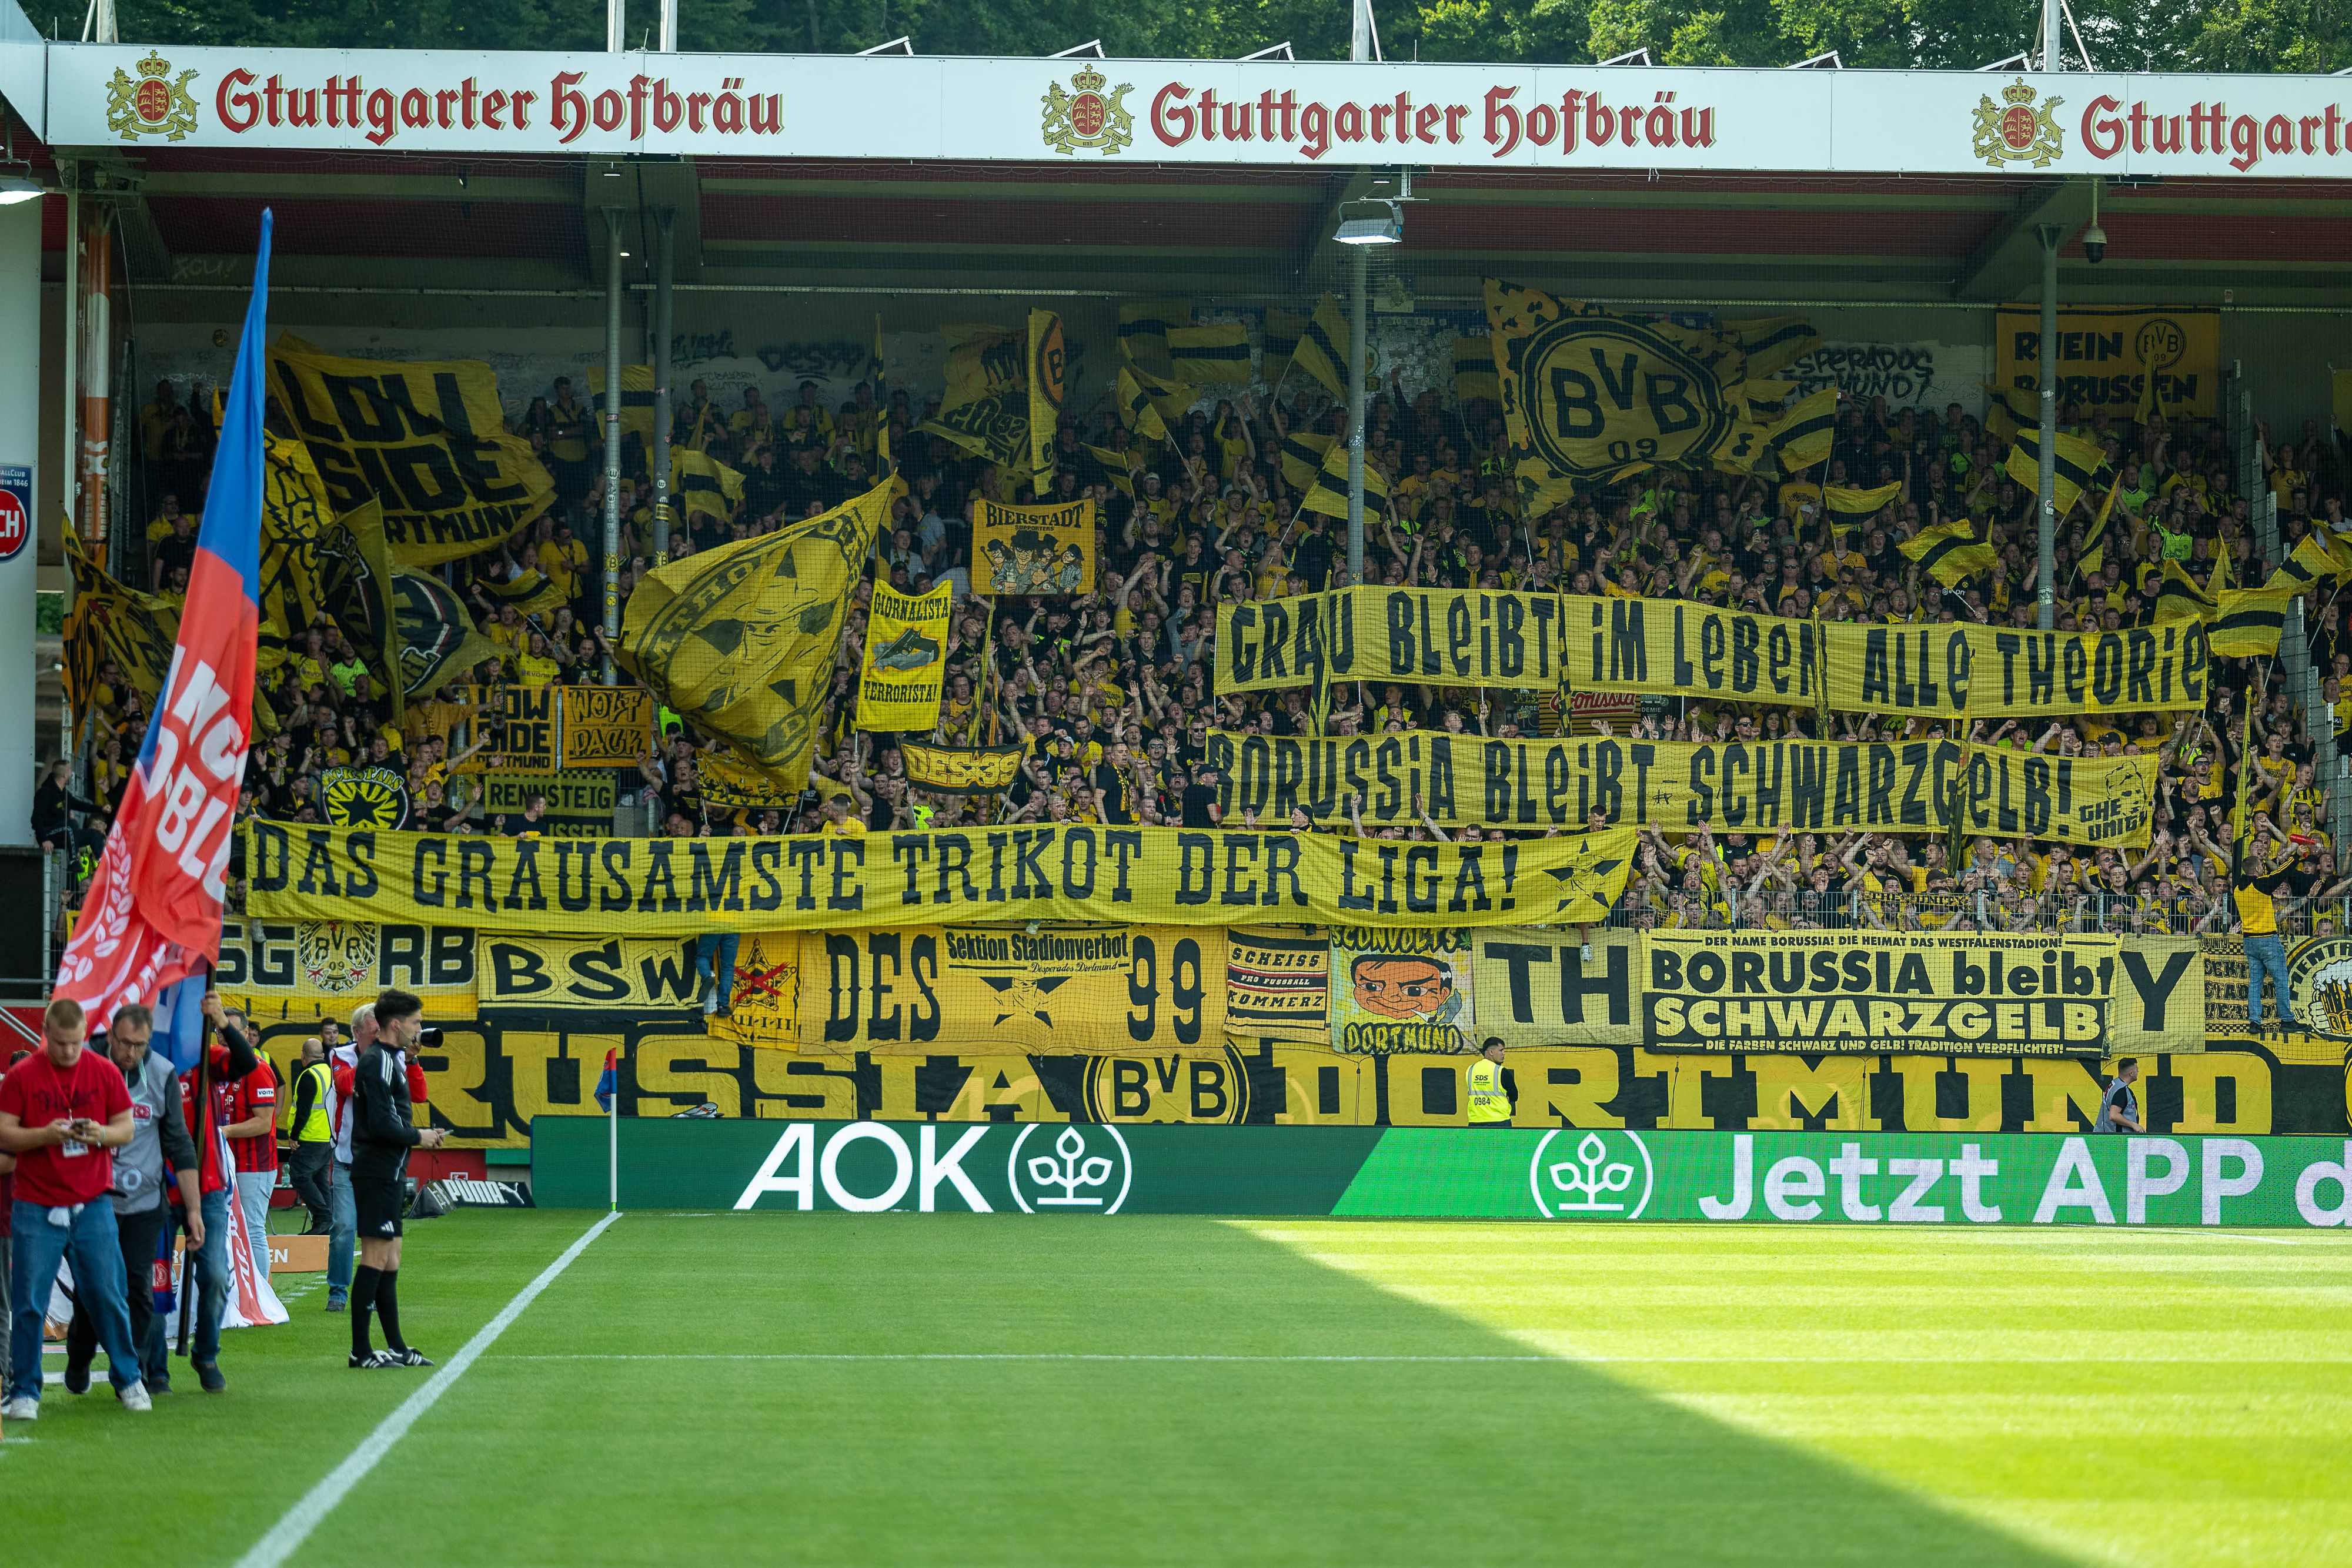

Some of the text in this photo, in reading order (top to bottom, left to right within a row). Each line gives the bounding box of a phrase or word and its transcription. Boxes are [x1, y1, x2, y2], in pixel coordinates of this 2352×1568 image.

[216, 67, 784, 146] Stuttgarter Hofbräu
[1151, 81, 1716, 160] Stuttgarter Hofbräu
[2081, 94, 2352, 173] Stuttgart
[275, 359, 482, 442] LOW
[1551, 347, 1701, 439] BVB
[1608, 437, 1658, 463] 09
[14, 479, 28, 487] 1846
[305, 434, 527, 512] SIDE
[986, 502, 1084, 529] BIERSTADT
[874, 591, 948, 622] GIORNALISTA
[1231, 591, 1354, 684] GRAU
[570, 690, 644, 723] WOLF
[864, 680, 938, 703] TERRORISTA!
[572, 728, 642, 757] PACK
[252, 823, 1518, 914] DAS GRAUSAMSTE TRIKOT DER LIGA!
[379, 924, 474, 986] RB
[946, 931, 1128, 961] Sektion Stadionverbot
[1232, 947, 1320, 968] SCHEISS
[1706, 936, 2063, 949] DER NAME BORUSSIA! DIE HEIMAT DAS WESTFALENSTADION!
[825, 932, 940, 1042] DES
[1264, 977, 1311, 985] FUSSBALL
[1651, 950, 1934, 995] BORUSSIA
[1124, 935, 1206, 1044] 99
[1228, 991, 1324, 1008] KOMMERZ
[1655, 998, 2101, 1041] SCHWARZGELB
[1344, 1022, 1464, 1055] DORTMUND
[1706, 1039, 2064, 1054] DIE FARBEN SCHWARZ UND GELB! TRADITION VERPFLICHTET!
[1474, 1097, 1491, 1105] 0984
[733, 1121, 994, 1212] AOK
[1698, 1134, 2002, 1223] Jetzt
[2033, 1137, 2264, 1225] APP
[442, 1179, 507, 1205] PUMA
